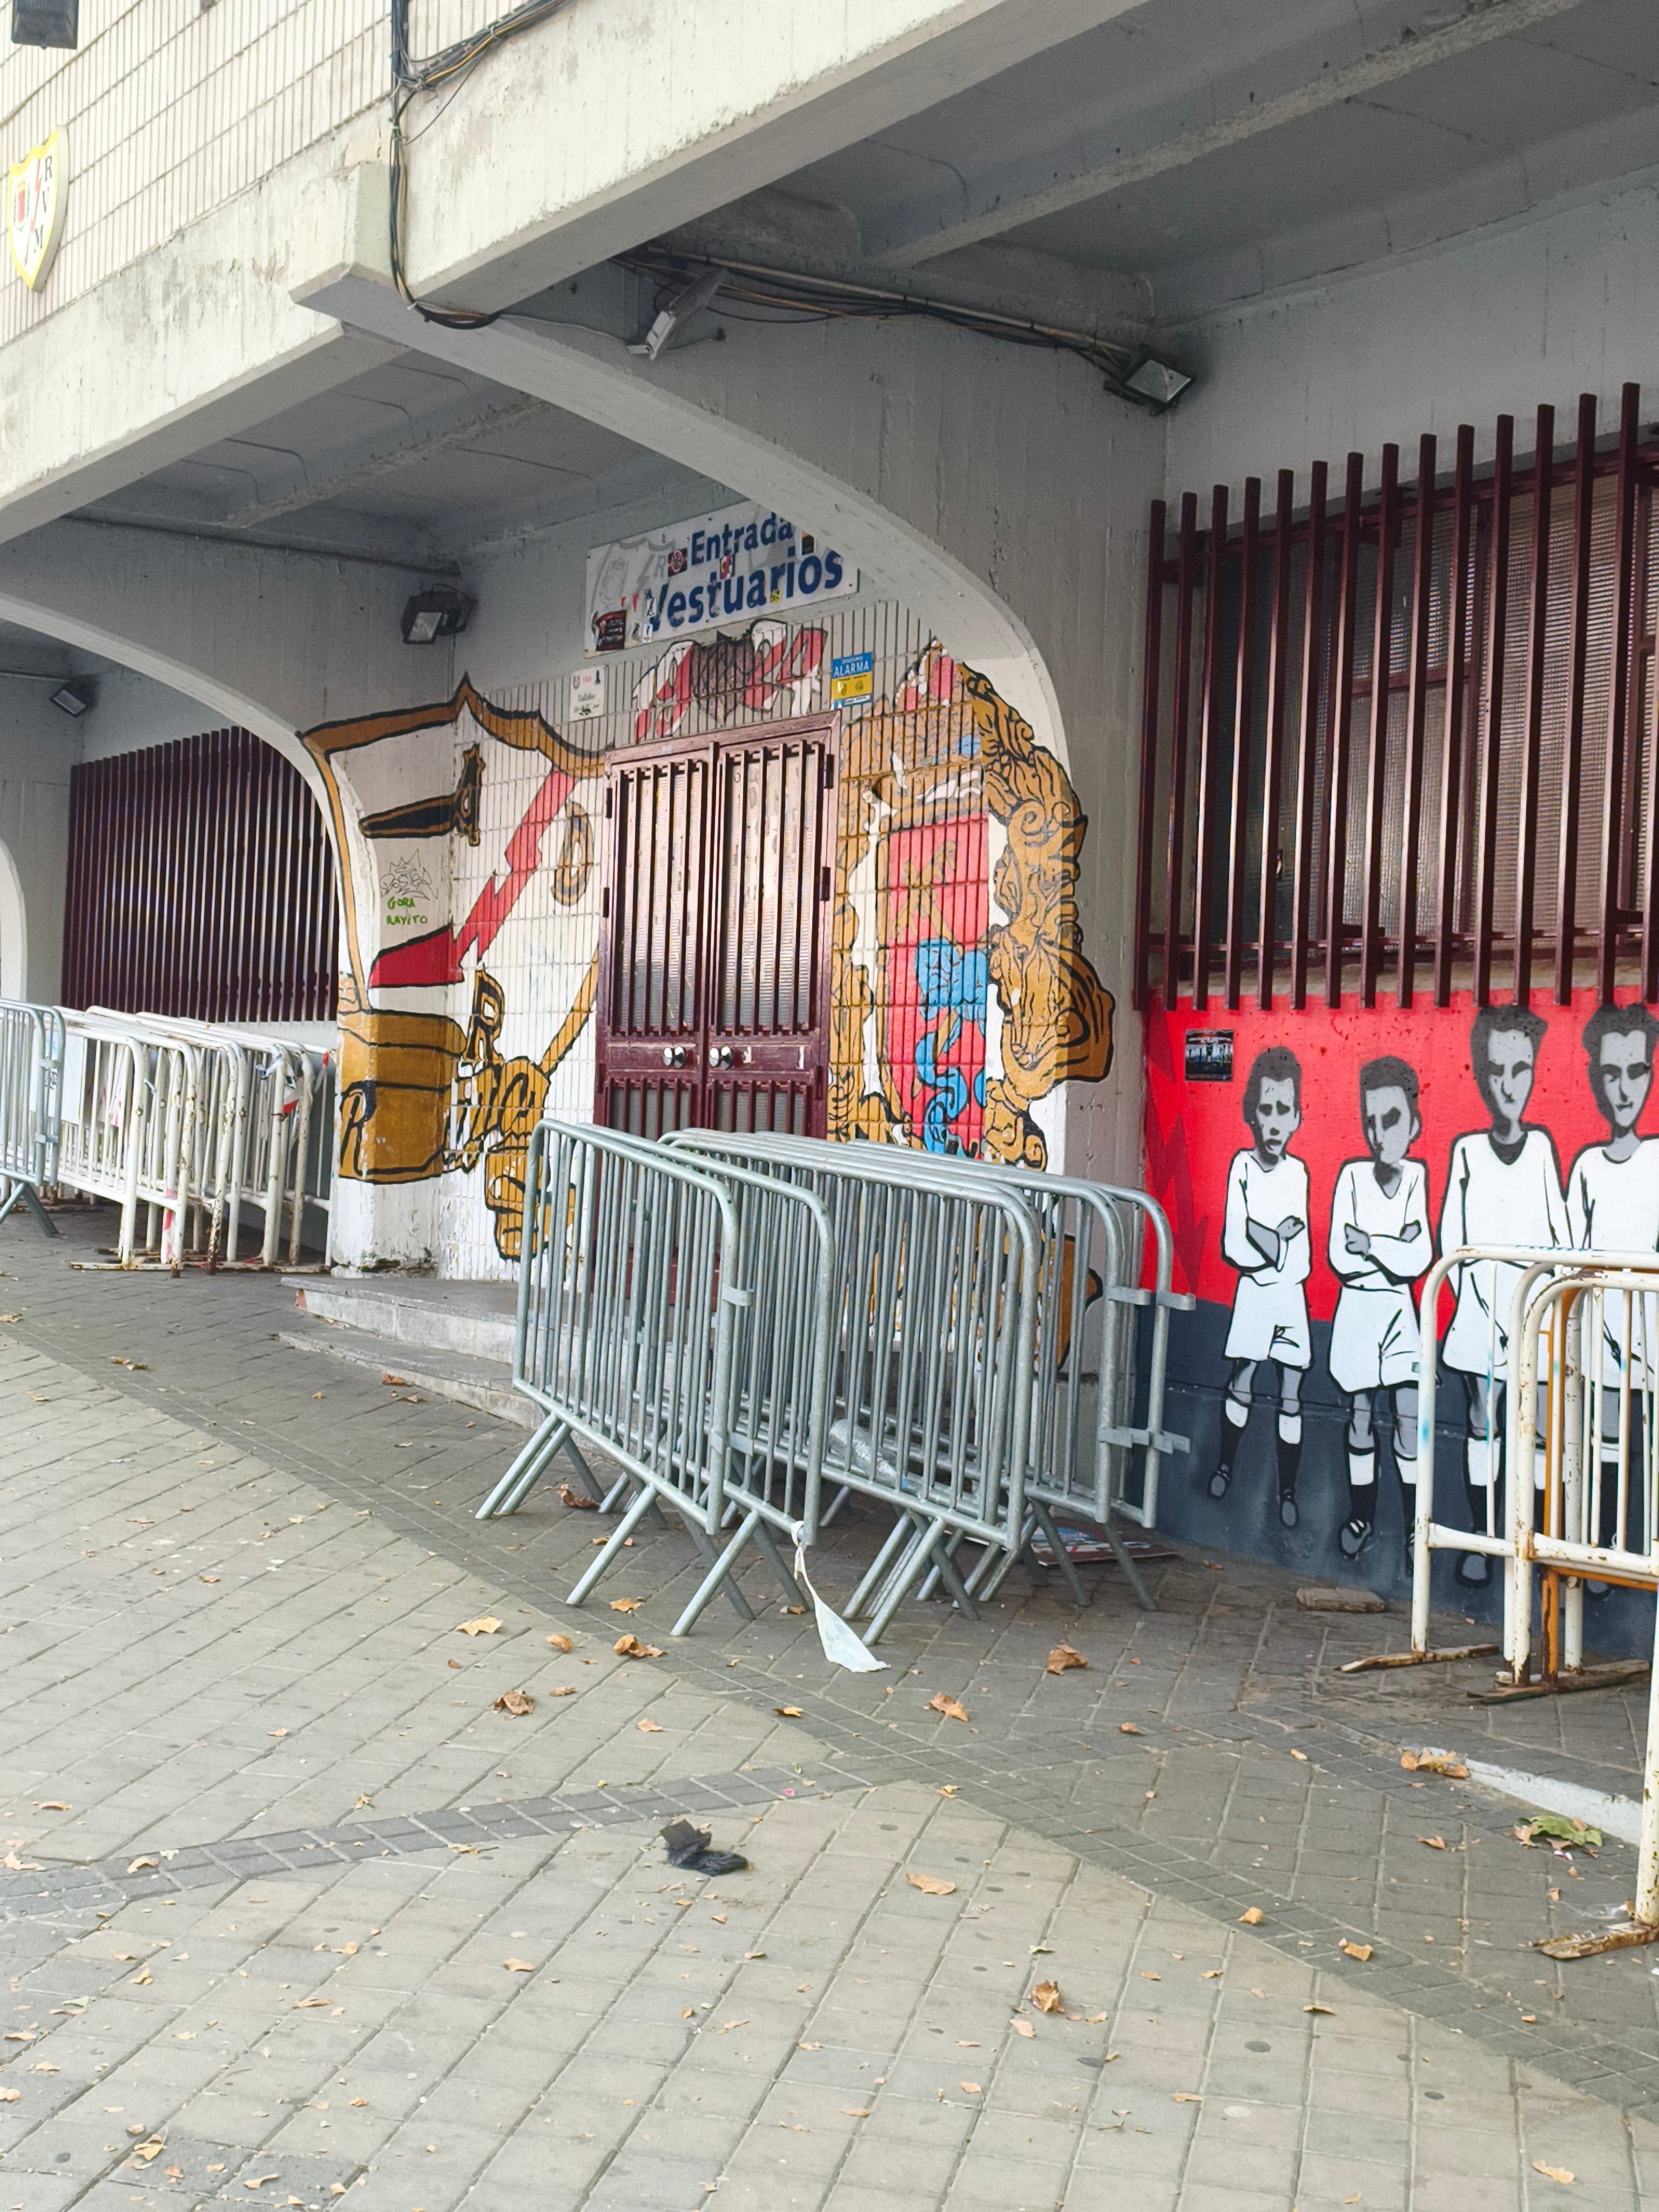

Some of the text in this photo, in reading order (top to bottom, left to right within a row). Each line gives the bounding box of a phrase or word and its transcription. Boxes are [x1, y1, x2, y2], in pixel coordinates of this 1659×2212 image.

[33, 155, 52, 253] R V M
[691, 511, 793, 566] Entrada
[644, 545, 843, 632] Vestuarios
[833, 660, 869, 678] ALARMA
[386, 914, 428, 926] RAYITO
[387, 896, 416, 909] GORA
